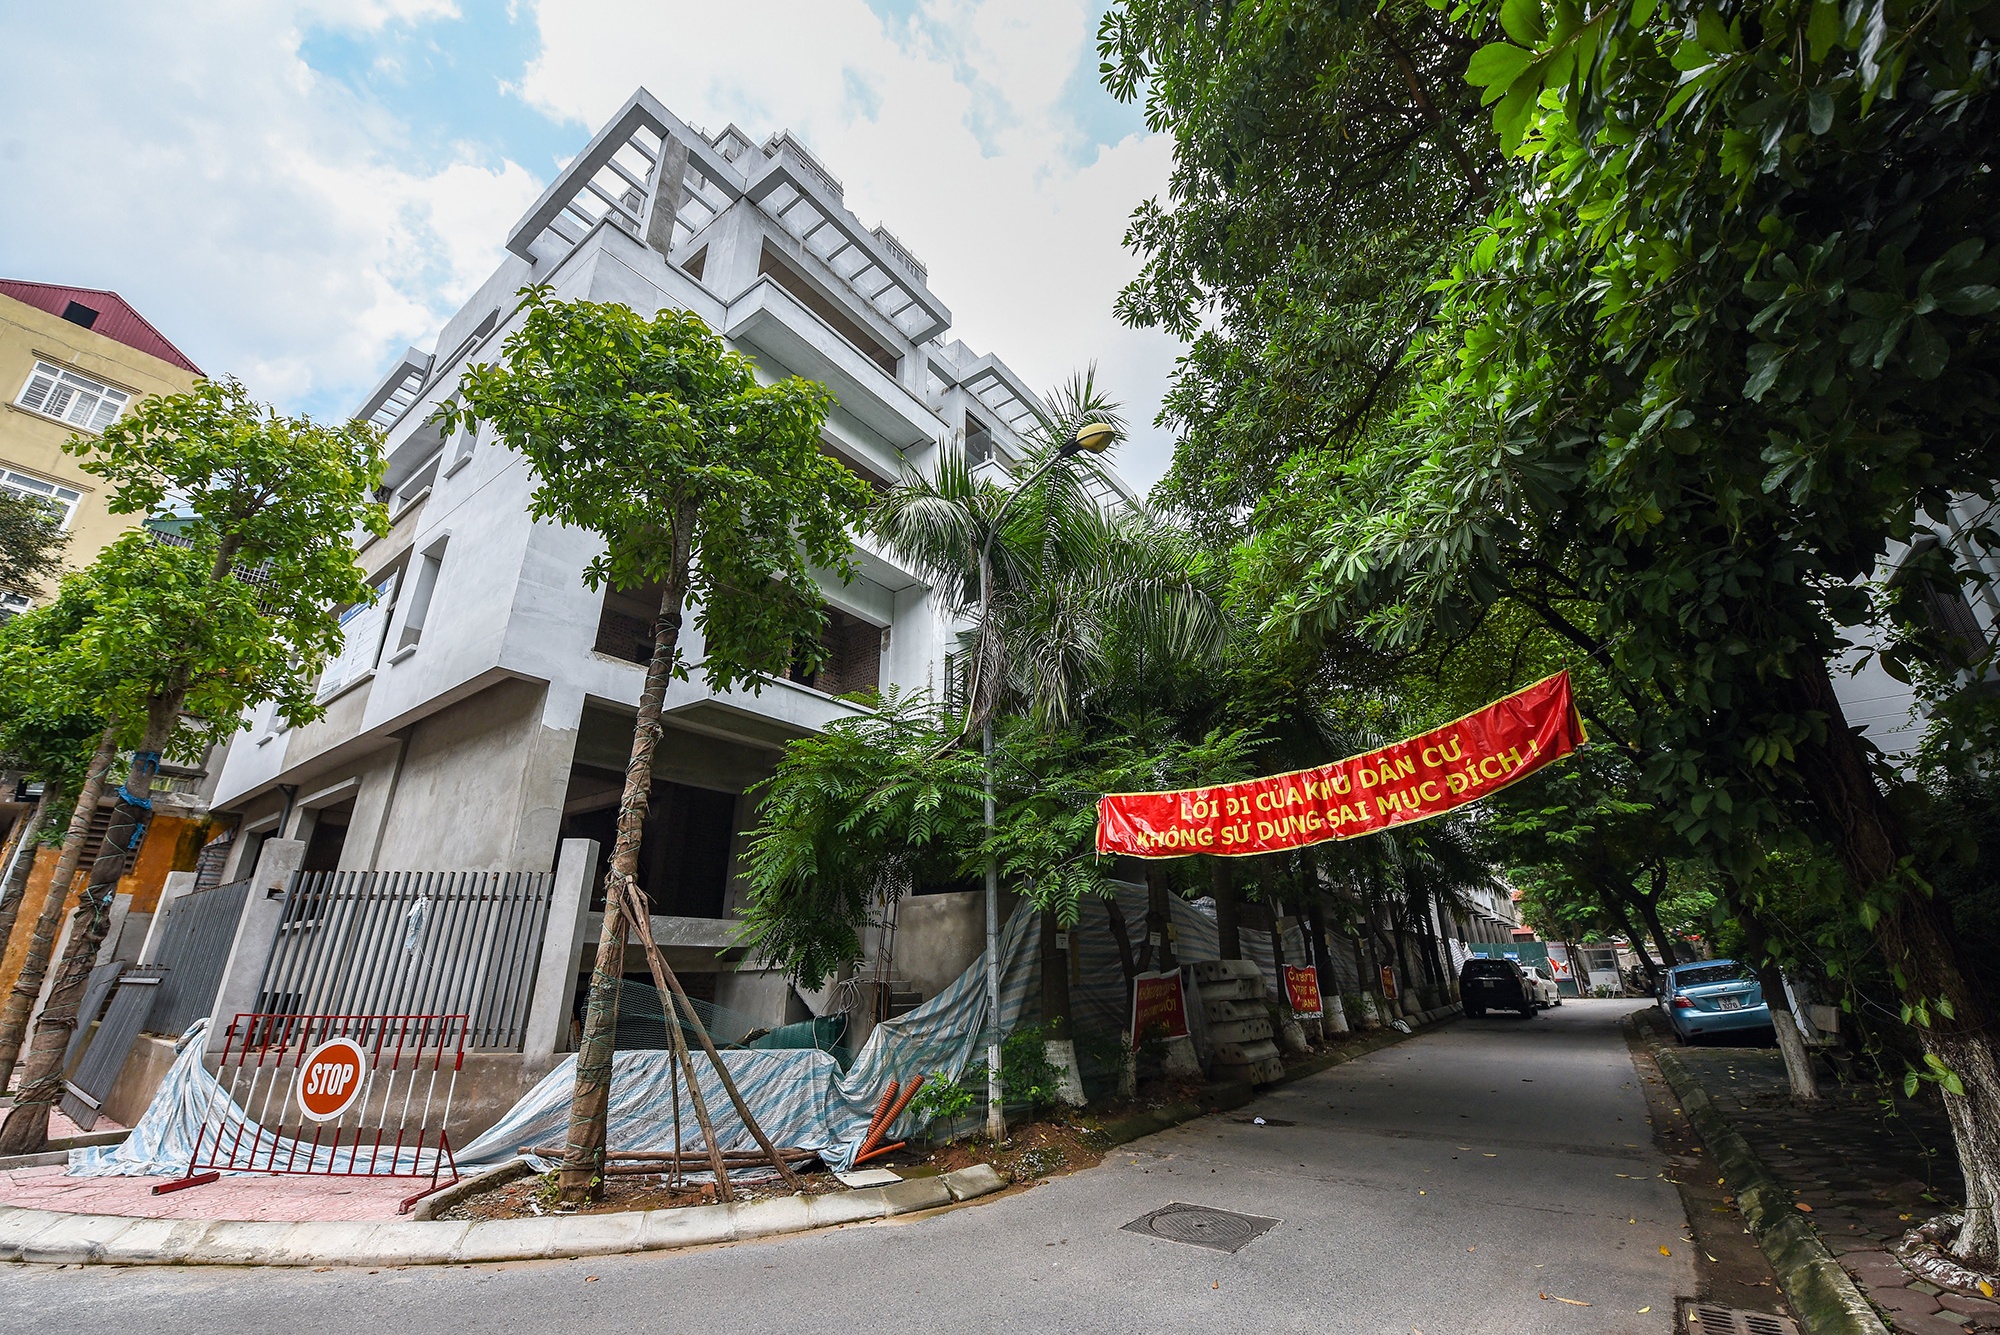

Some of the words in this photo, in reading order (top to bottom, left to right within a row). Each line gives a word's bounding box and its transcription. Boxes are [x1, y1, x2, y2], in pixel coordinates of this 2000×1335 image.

[1136, 825, 1214, 848] KHÔNG
[1221, 818, 1251, 845] SỬ
[1257, 811, 1322, 843] DỤNG
[1327, 800, 1371, 829] SAI
[1375, 780, 1442, 813] MỤC
[1446, 746, 1524, 795] ĐÍCH
[1226, 796, 1251, 816] ĐI
[1256, 785, 1304, 812] CỦA
[1305, 775, 1352, 801] KHU
[1358, 755, 1416, 790] DÂN
[1421, 733, 1462, 768] CƯ
[307, 1062, 354, 1096] STOP
